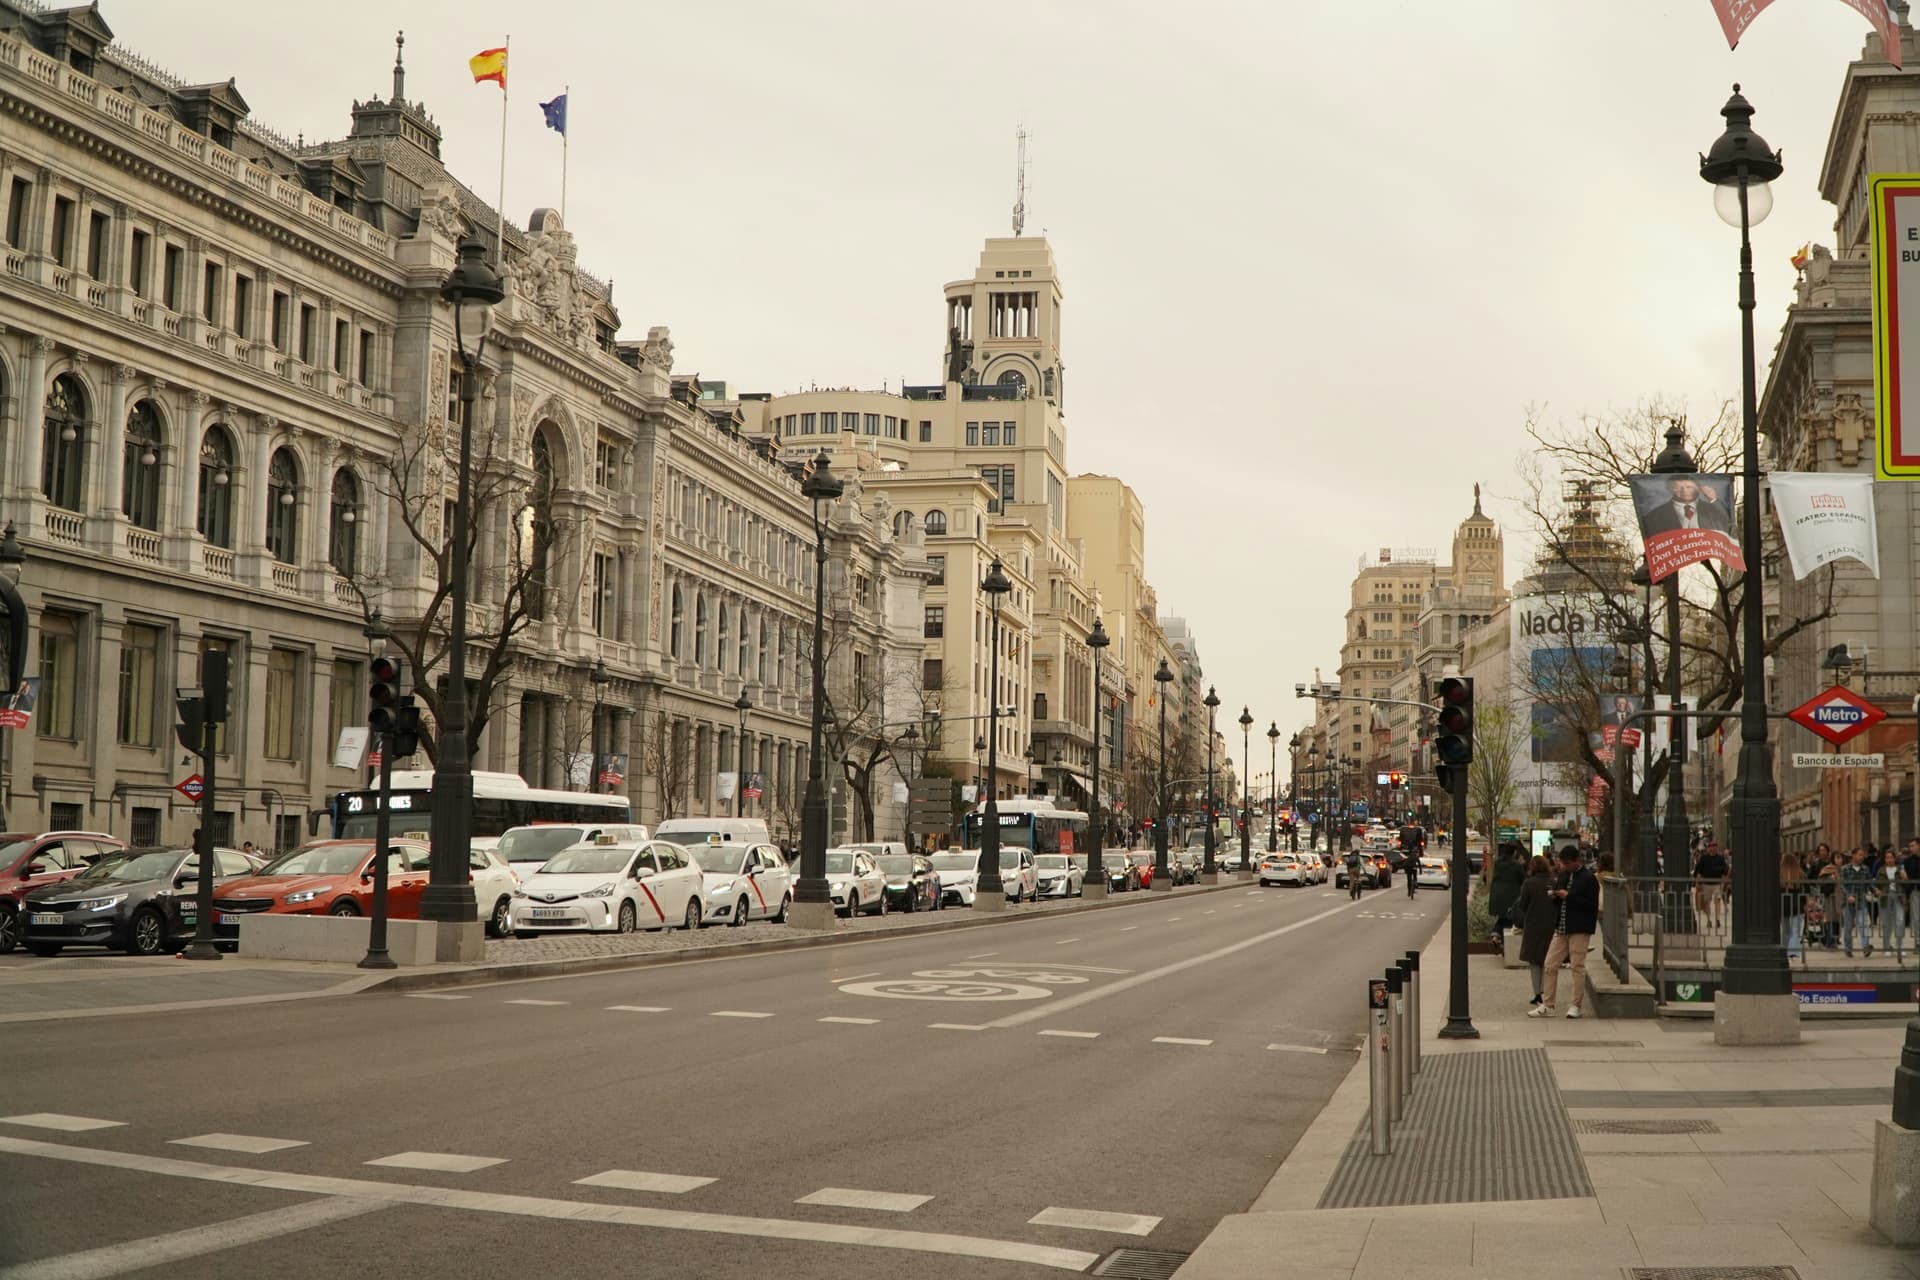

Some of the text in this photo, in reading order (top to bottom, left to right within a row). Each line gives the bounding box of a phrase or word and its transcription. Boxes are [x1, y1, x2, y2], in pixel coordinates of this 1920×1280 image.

[1796, 512, 1828, 526] TEATRO
[1656, 537, 1675, 552] mar
[1688, 530, 1707, 540] abr
[1651, 550, 1672, 566] Don
[1673, 539, 1712, 554] Ramón
[1654, 564, 1668, 578] del
[1520, 606, 1585, 637] Nada
[1818, 708, 1860, 721] Metro
[1797, 756, 1879, 767] Banco de España
[348, 797, 363, 811] 20
[887, 983, 1002, 996] 30
[1812, 994, 1848, 1004] España
